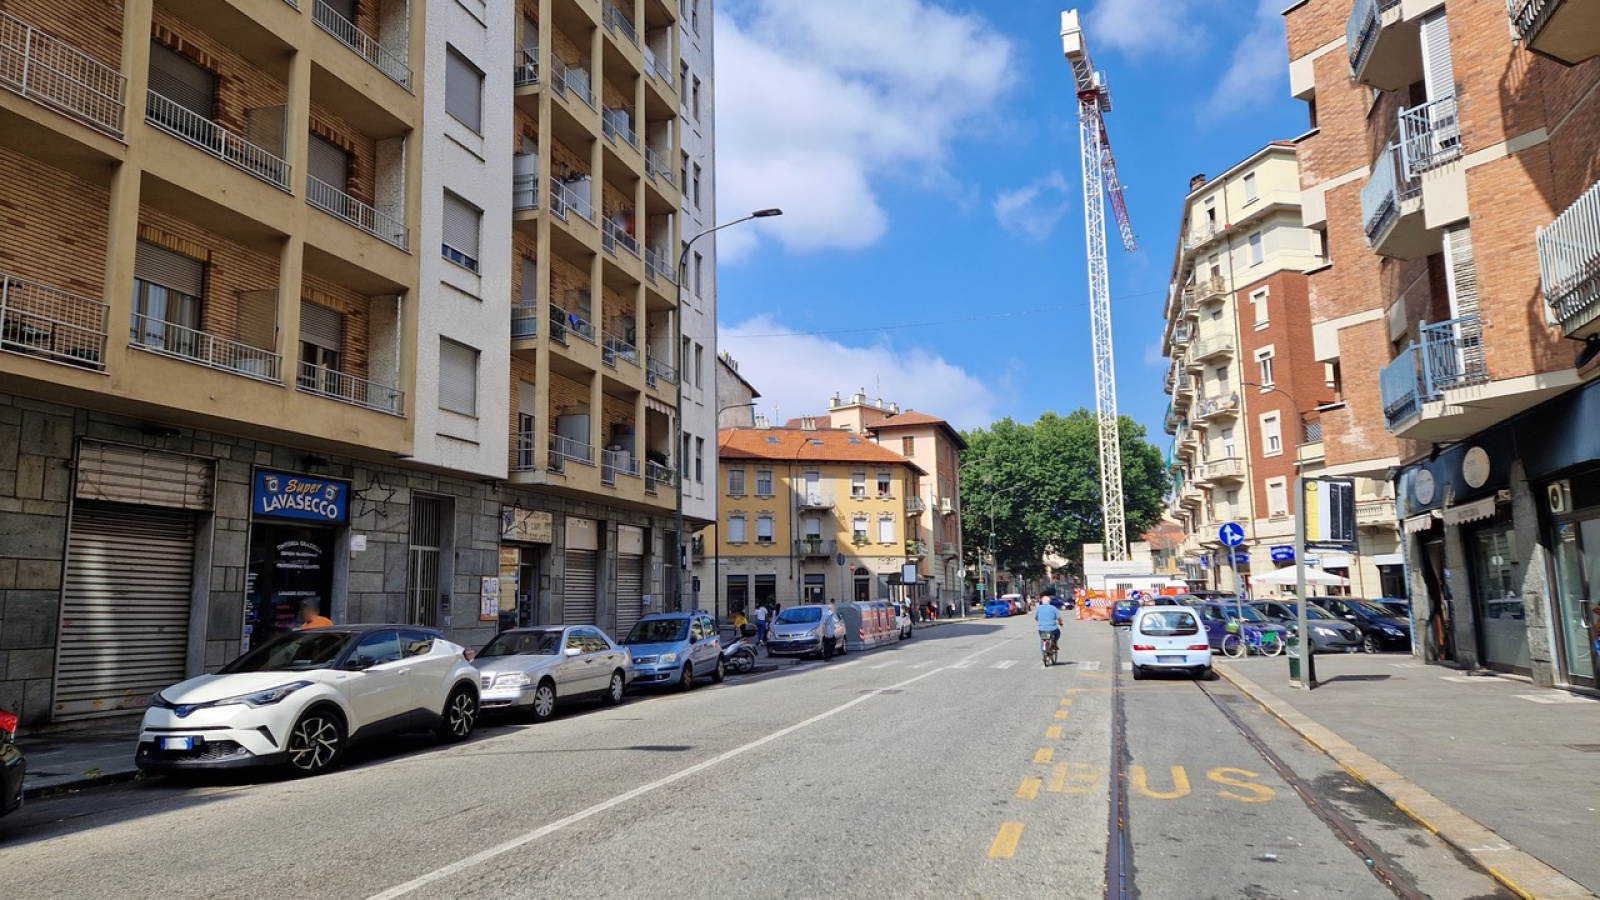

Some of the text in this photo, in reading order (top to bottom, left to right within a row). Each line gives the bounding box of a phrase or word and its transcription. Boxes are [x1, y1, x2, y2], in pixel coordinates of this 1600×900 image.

[285, 479, 322, 495] Super
[262, 494, 338, 519] LAVASECCO
[1047, 761, 1276, 803] BUS
